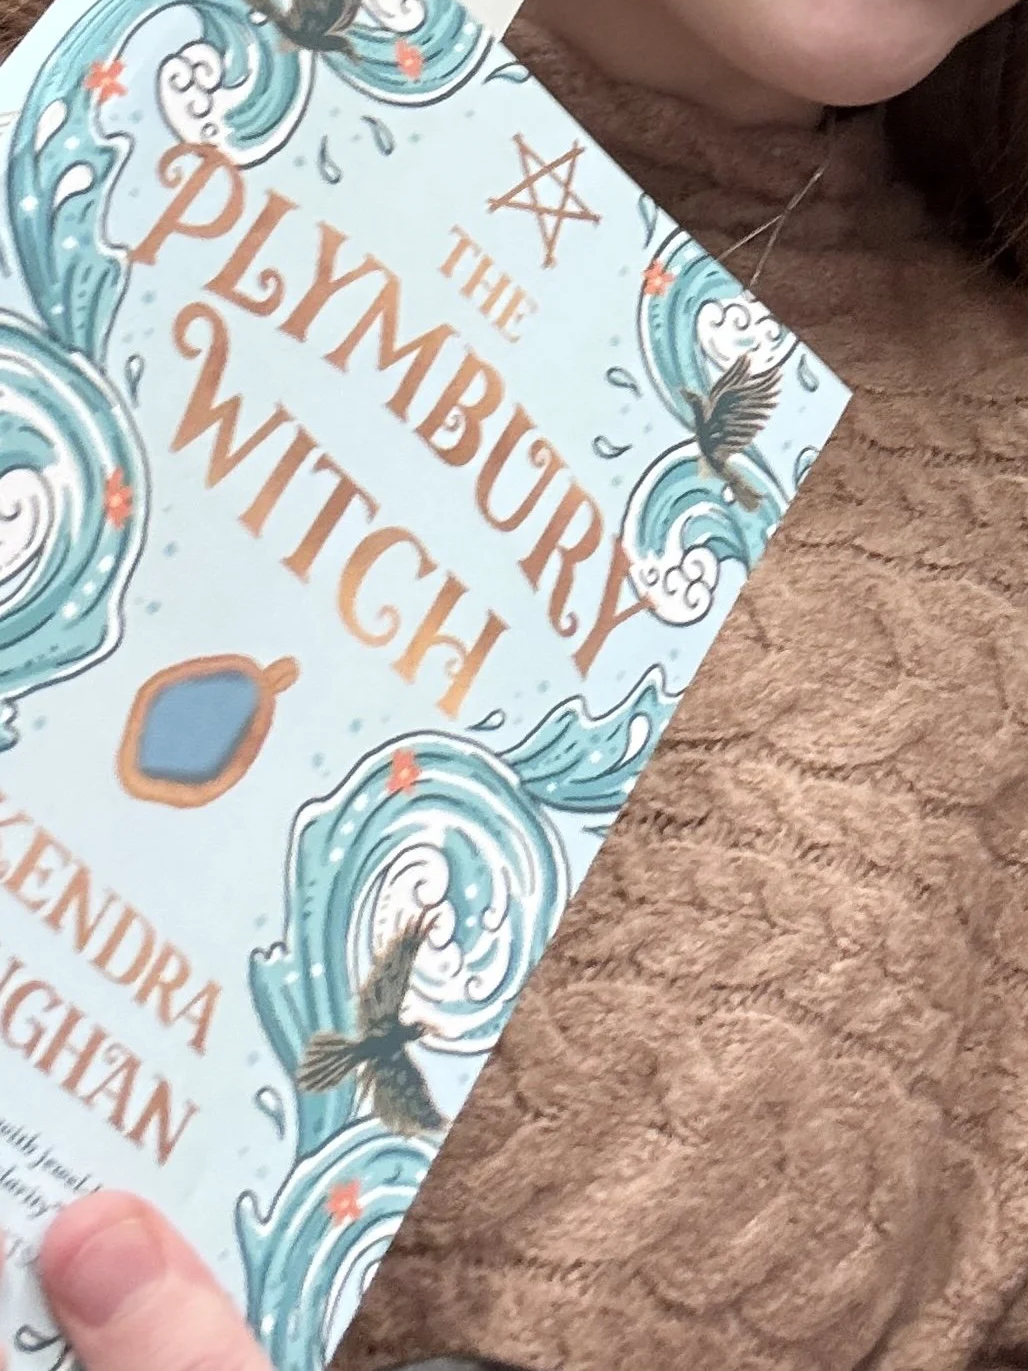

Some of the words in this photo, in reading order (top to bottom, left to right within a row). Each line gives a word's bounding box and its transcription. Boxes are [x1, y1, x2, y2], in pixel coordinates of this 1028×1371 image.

[126, 141, 660, 682] PLYMBURY
[437, 224, 540, 344] THE
[168, 301, 510, 720] WITCH
